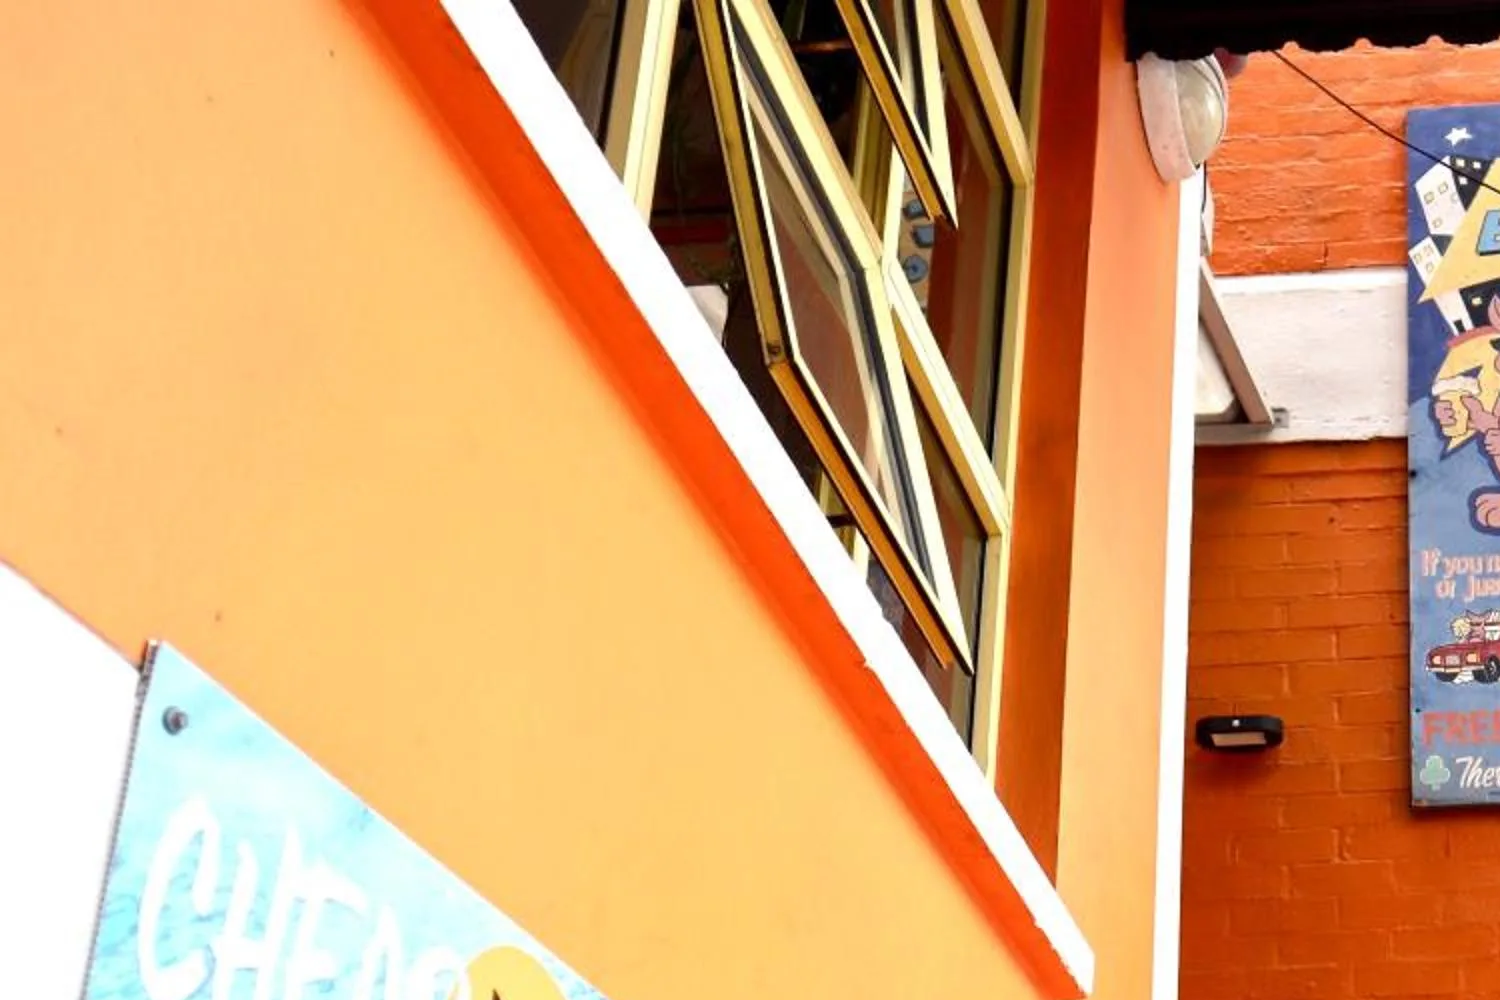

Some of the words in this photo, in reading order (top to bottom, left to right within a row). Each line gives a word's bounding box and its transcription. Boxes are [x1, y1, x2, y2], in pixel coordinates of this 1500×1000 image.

[1421, 547, 1440, 577] If
[1440, 556, 1483, 579] you
[1435, 578, 1457, 599] or
